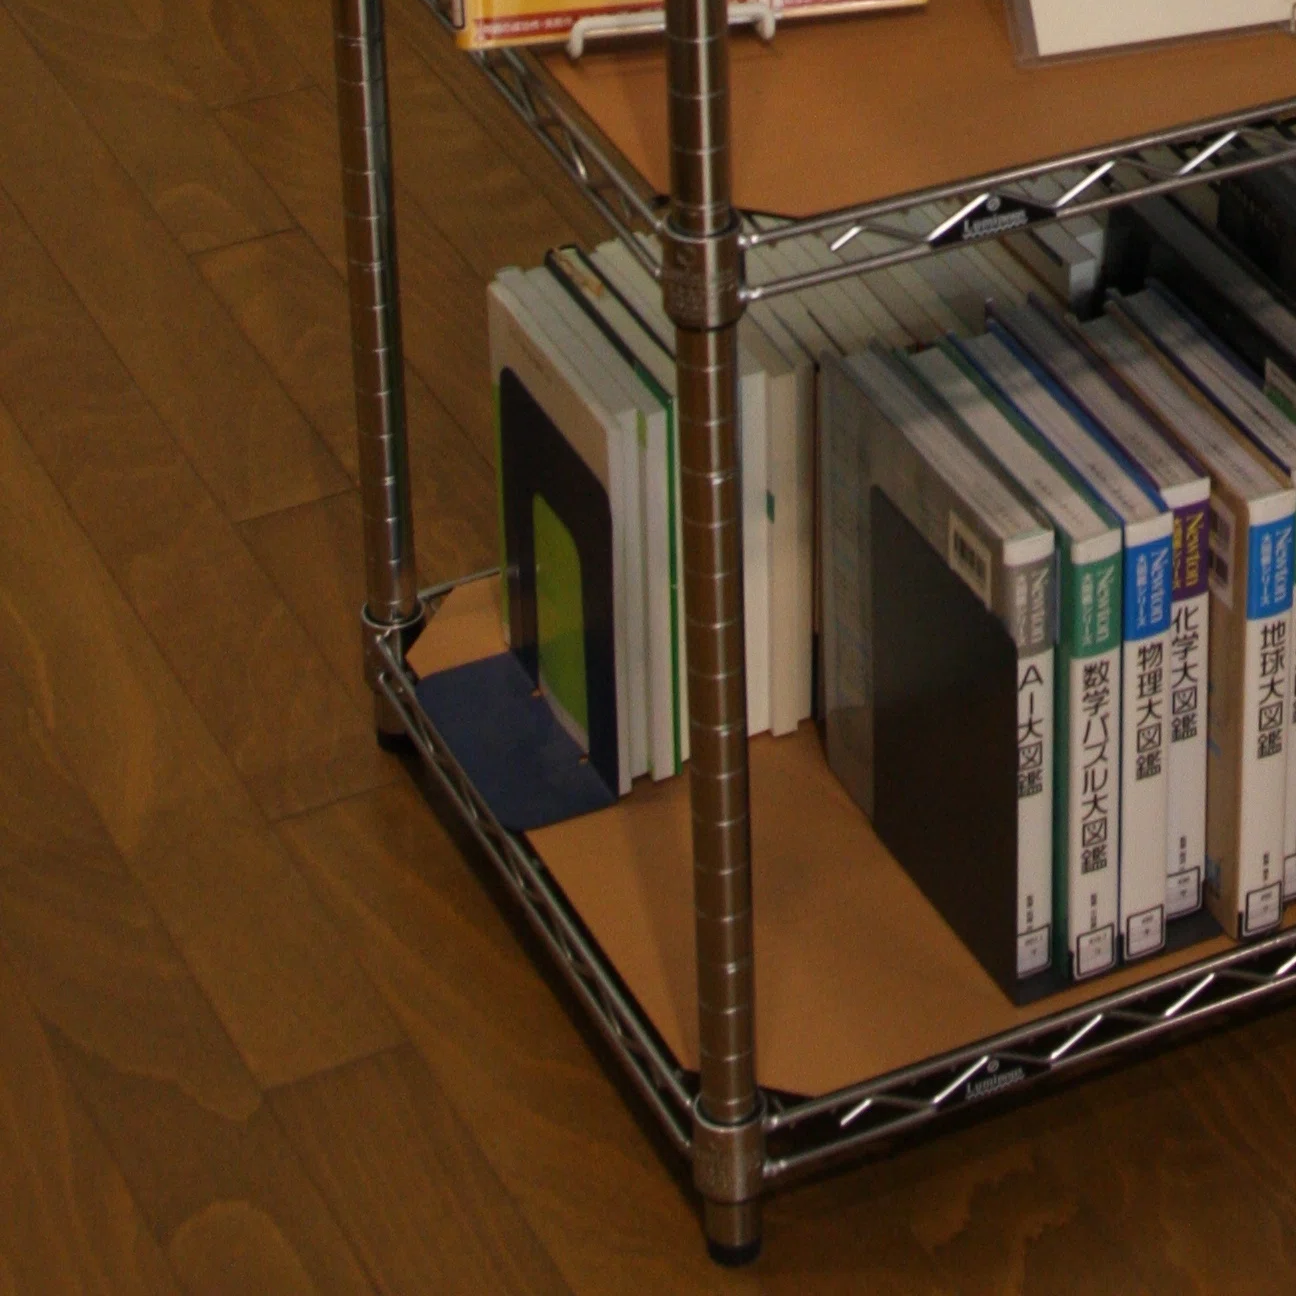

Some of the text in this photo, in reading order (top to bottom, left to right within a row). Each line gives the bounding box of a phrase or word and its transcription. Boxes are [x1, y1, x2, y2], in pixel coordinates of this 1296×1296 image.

[1150, 547, 1169, 624] Newton
[1184, 509, 1203, 587] Newton
[1274, 528, 1292, 603] Newton
[1031, 567, 1049, 645] Newton
[1096, 565, 1115, 643] Newton
[1136, 642, 1163, 782] 物理大図鑑
[1170, 607, 1198, 744] 化学大図鑑
[1256, 622, 1286, 762] 地球大図鑑
[1081, 659, 1109, 875] 数学パズル大図鑑
